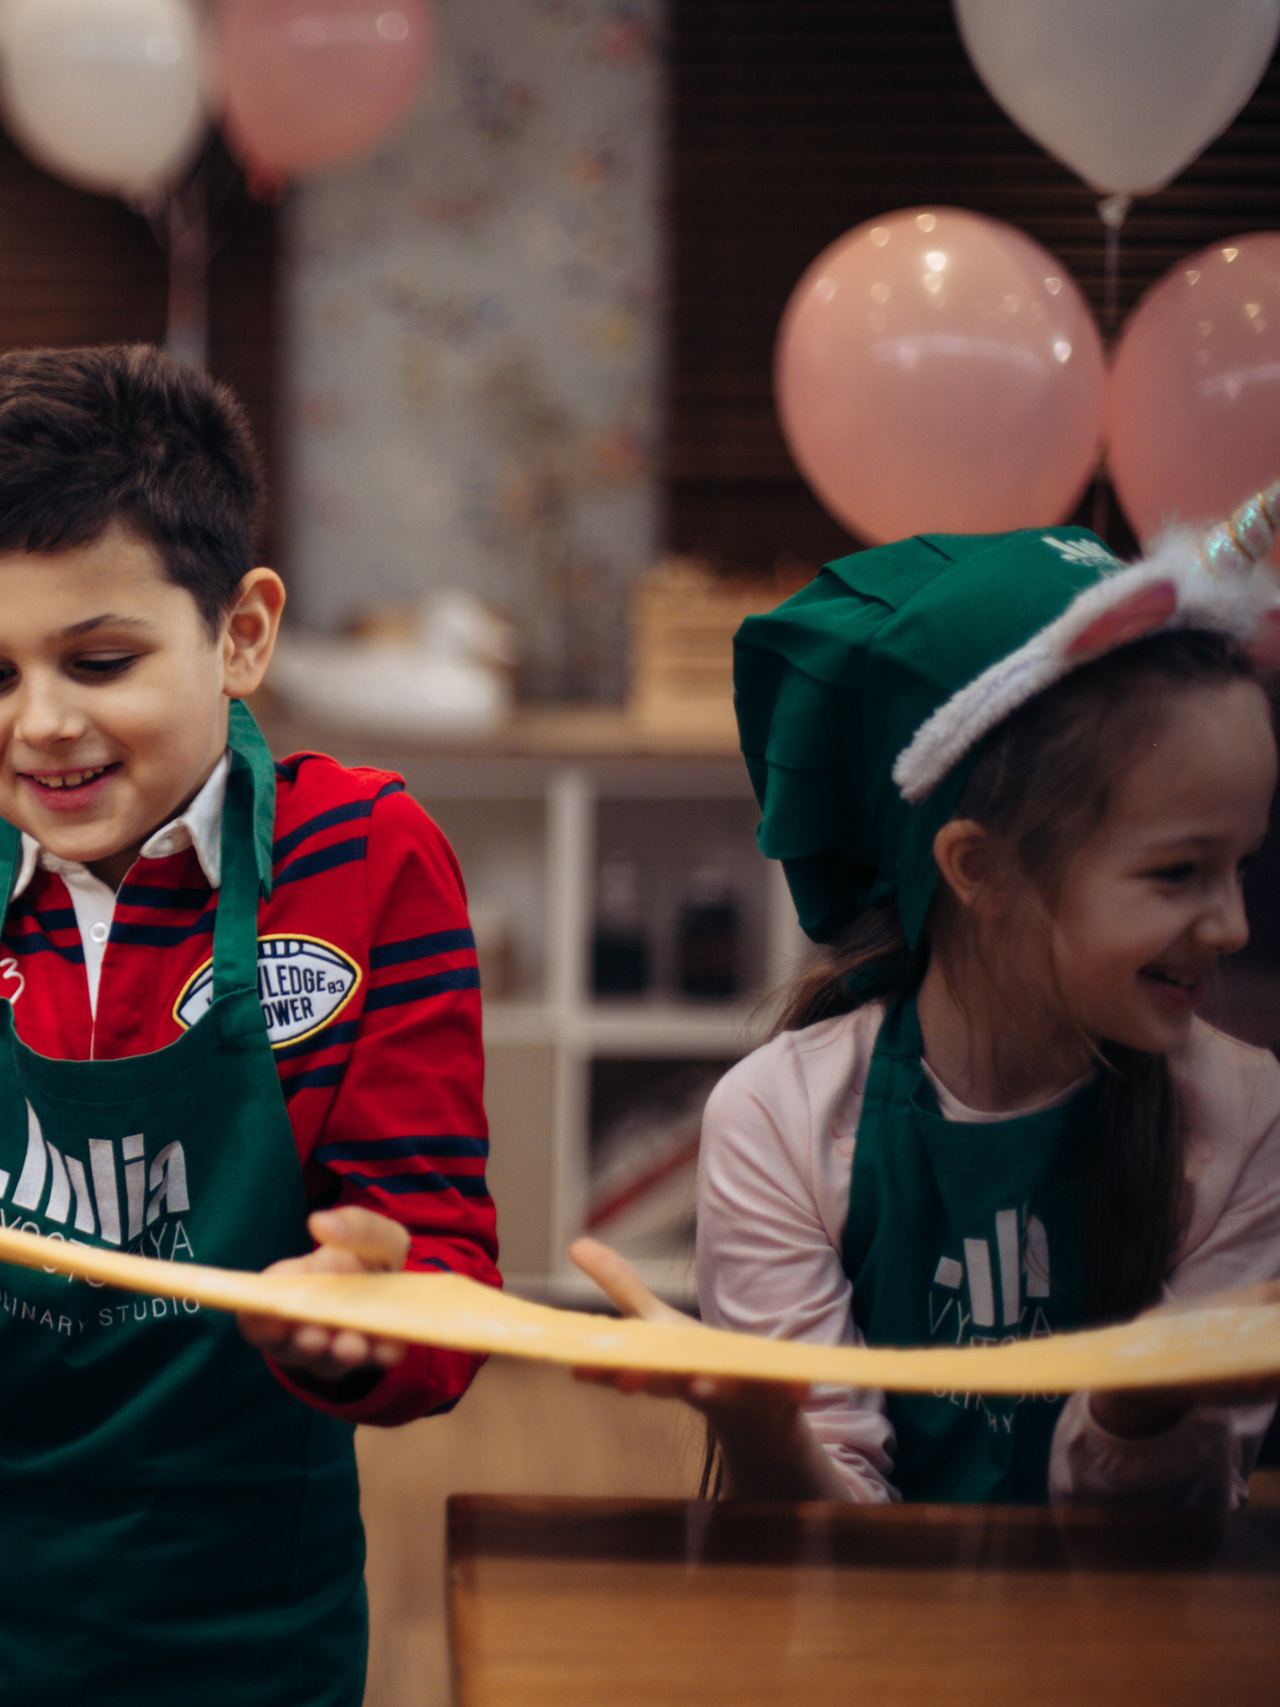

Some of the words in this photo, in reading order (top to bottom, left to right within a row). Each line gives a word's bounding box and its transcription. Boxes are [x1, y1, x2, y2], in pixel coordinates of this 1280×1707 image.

[257, 963, 327, 1000] LEDGE
[327, 978, 346, 995] 83
[261, 996, 315, 1030] OWER
[98, 1296, 201, 1328] STUDIO
